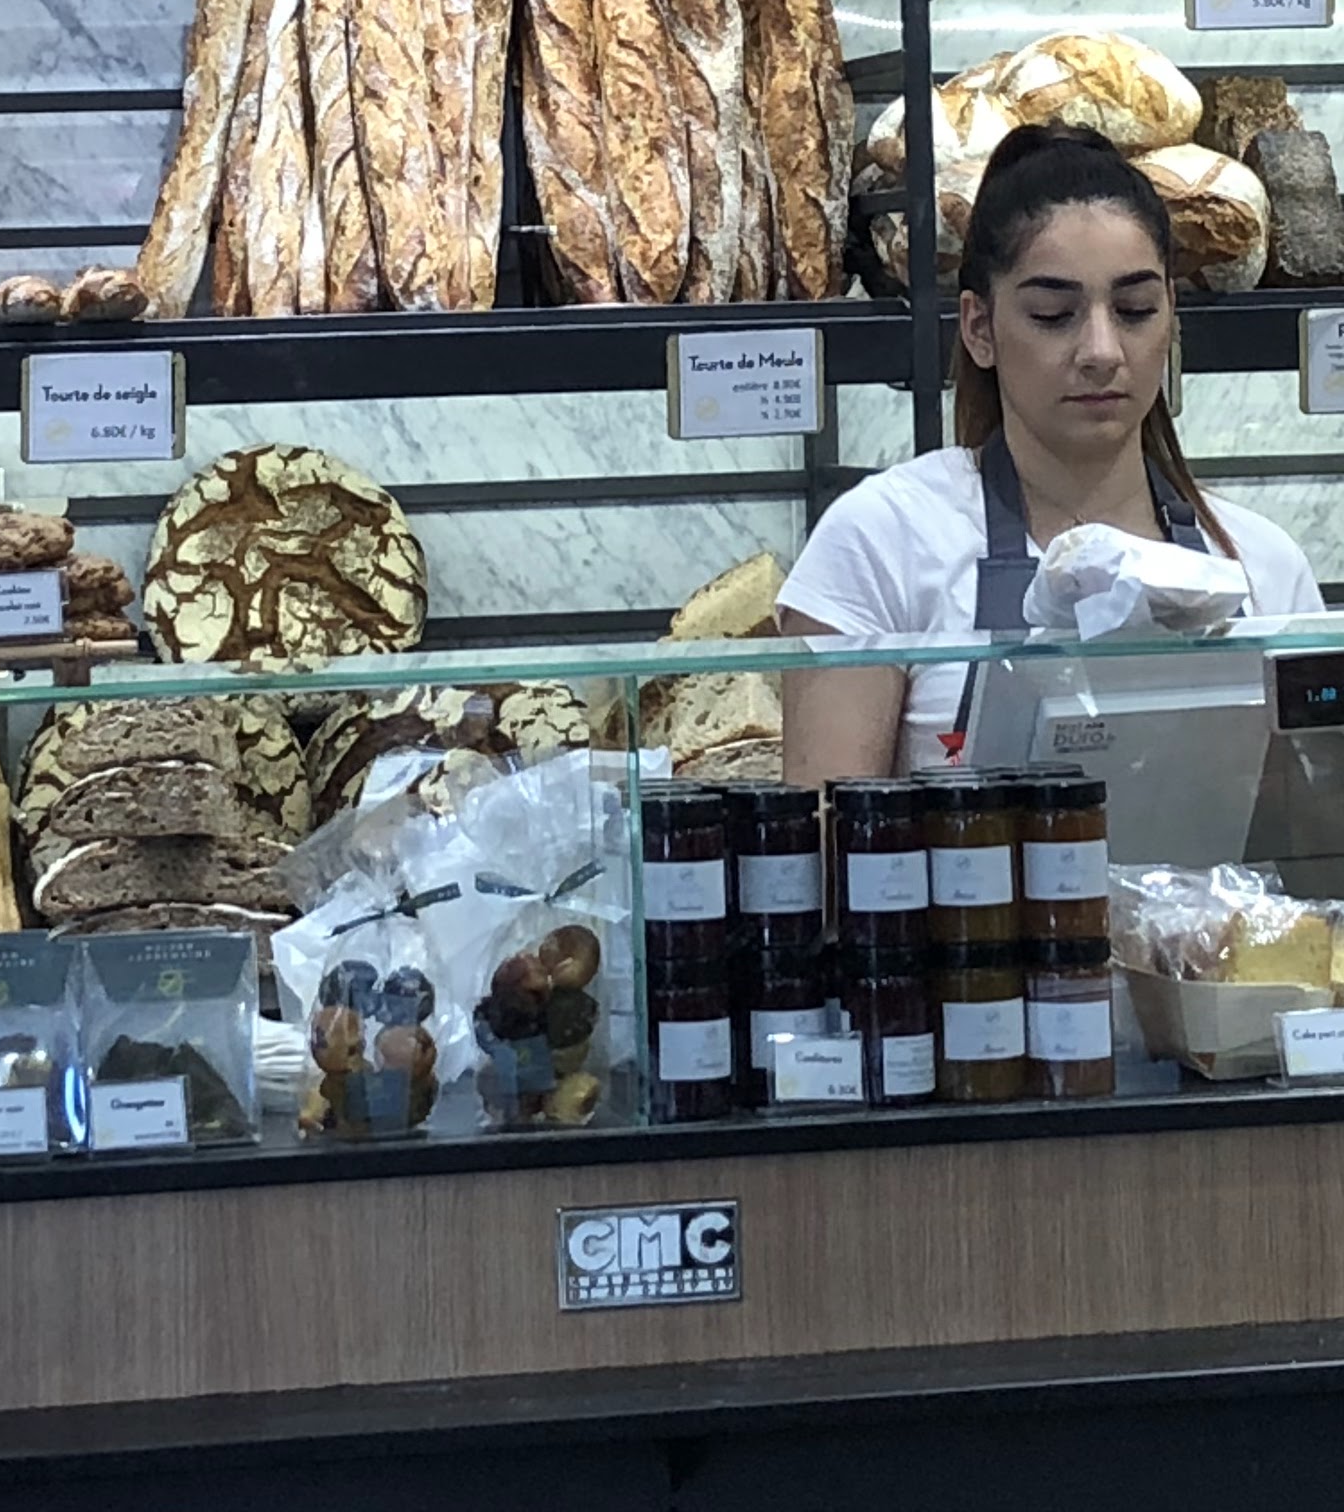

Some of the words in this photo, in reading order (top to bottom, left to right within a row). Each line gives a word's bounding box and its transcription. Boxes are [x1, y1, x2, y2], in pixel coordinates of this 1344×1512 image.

[688, 353, 735, 372] Tourte
[736, 352, 756, 370] de
[757, 350, 804, 369] Meule
[42, 385, 90, 403] Tourte
[92, 383, 112, 402] de
[114, 383, 158, 404] seigle
[140, 425, 156, 440] kg
